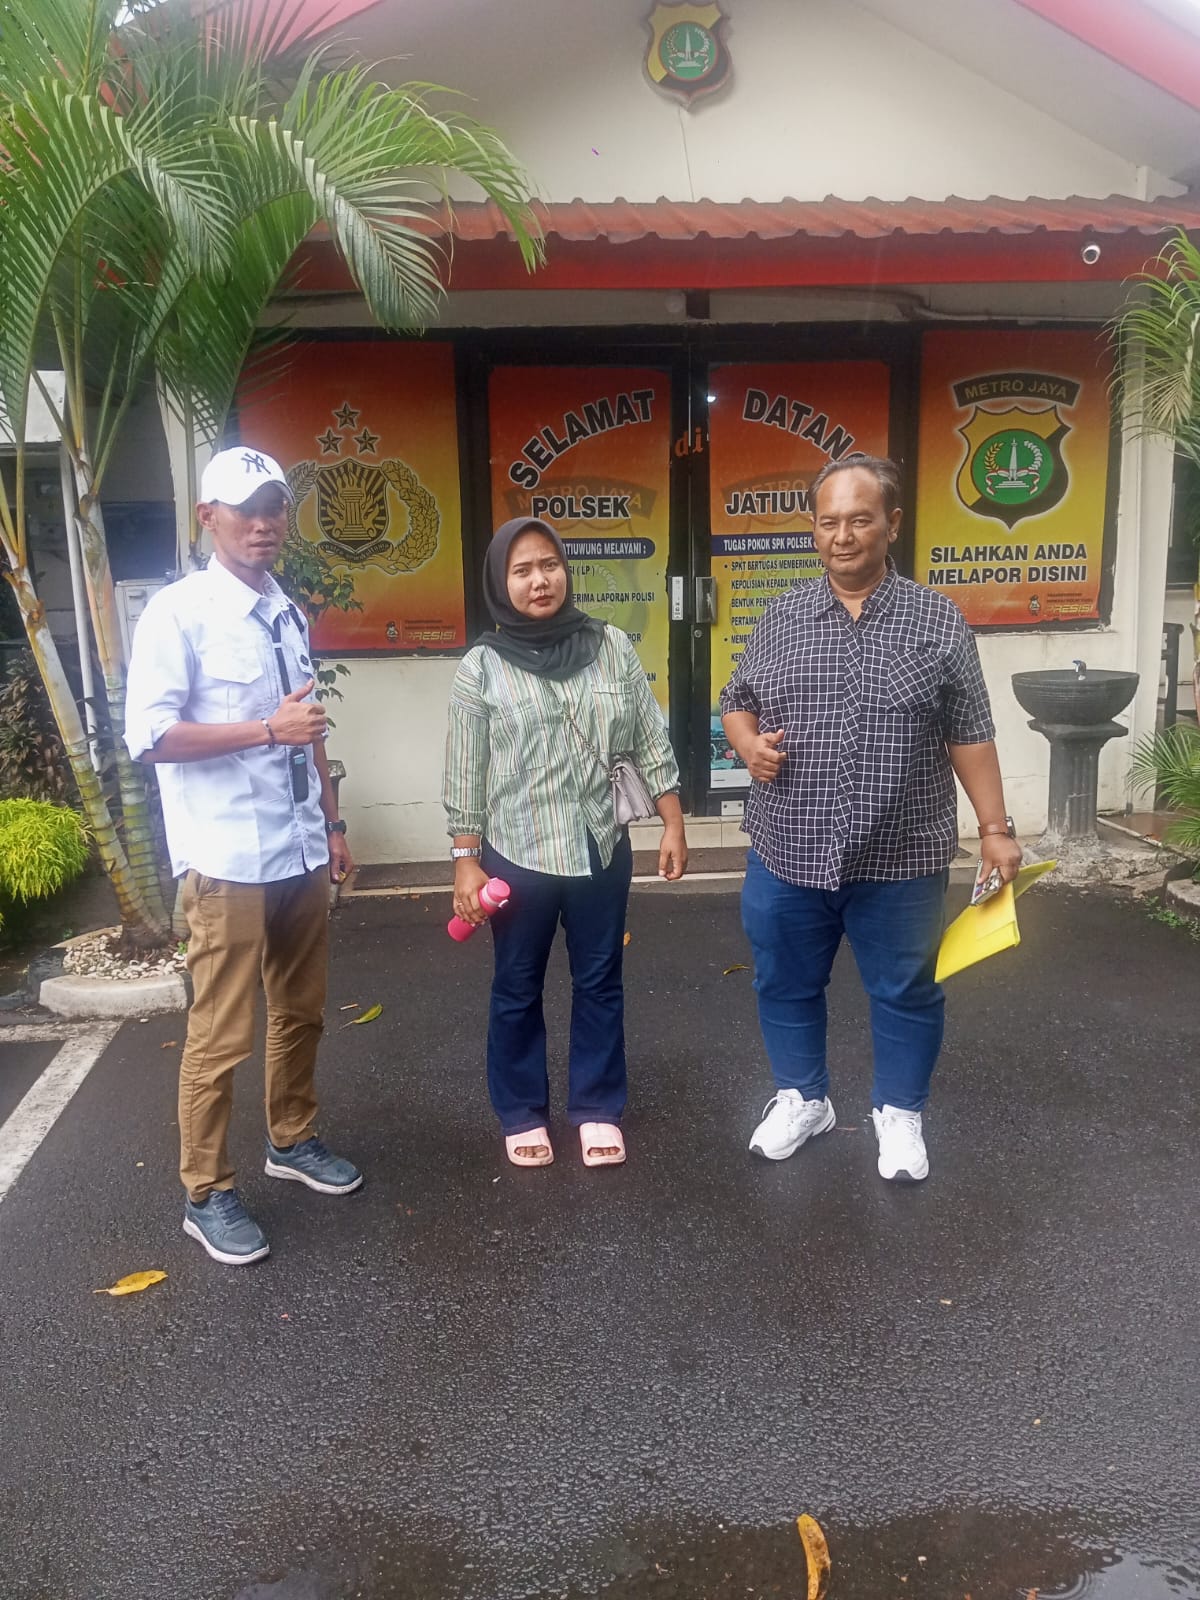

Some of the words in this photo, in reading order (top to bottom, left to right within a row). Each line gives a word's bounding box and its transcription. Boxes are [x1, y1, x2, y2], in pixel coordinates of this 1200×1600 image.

[964, 379, 1024, 400] METRO
[1027, 380, 1067, 399] JAYA
[509, 389, 654, 489] SELAMAT
[743, 388, 867, 464] DATAN
[674, 427, 704, 458] di
[532, 495, 631, 520] POLSEK
[604, 542, 642, 555] MELAYANI
[723, 539, 746, 551] TUGAS
[747, 538, 770, 550] POKOK
[772, 538, 785, 550] SPK
[786, 537, 812, 549] POLSEK
[930, 545, 1028, 564] SILAHKAN
[1034, 543, 1087, 561] ANDA
[731, 561, 746, 571] SPKT
[747, 560, 777, 570] BERTUGAS
[779, 559, 816, 570] MEMBERIKAN
[928, 567, 1021, 586] MELAPOR
[1027, 565, 1087, 583] DISINI
[731, 578, 765, 590] KEPOLISIAN
[766, 577, 788, 589] KEPADA
[596, 592, 629, 603] LAPORAN
[631, 592, 654, 602] POLISI
[731, 597, 754, 608] BENTUK
[731, 616, 756, 626] PERTAMA
